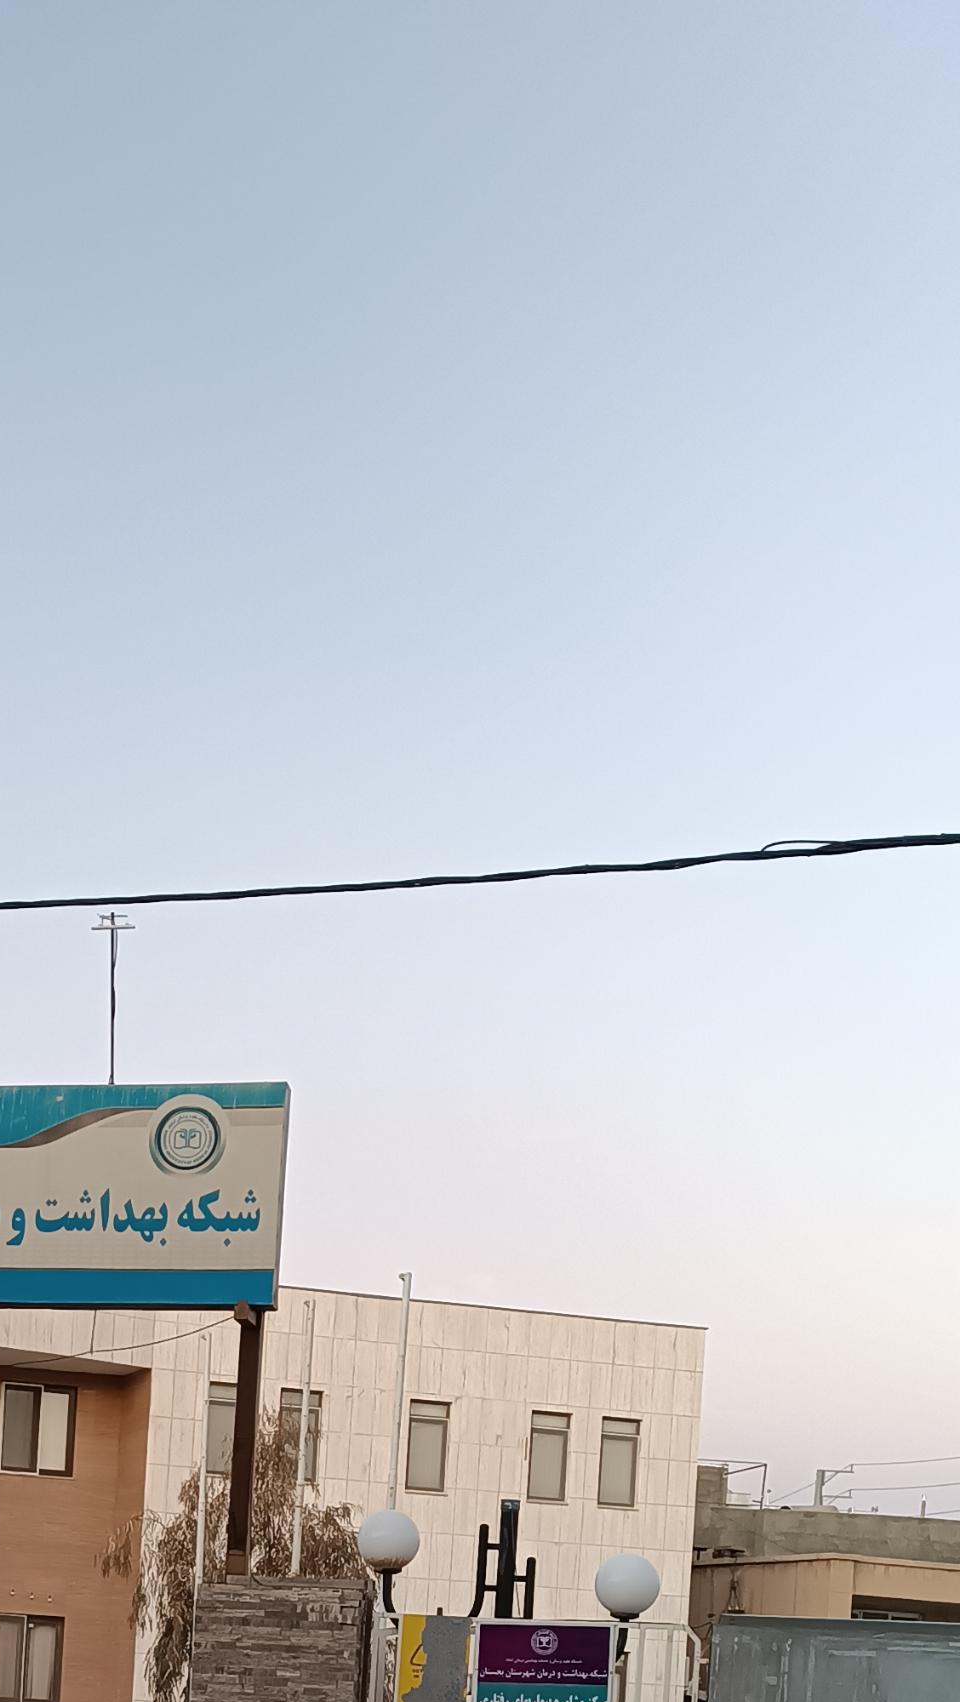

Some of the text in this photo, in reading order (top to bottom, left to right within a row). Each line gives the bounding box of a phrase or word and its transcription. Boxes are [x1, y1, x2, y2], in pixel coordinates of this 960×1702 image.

[6, 1207, 27, 1246] و
[35, 1188, 169, 1247] بهداشت
[177, 1188, 261, 1247] شبکه
